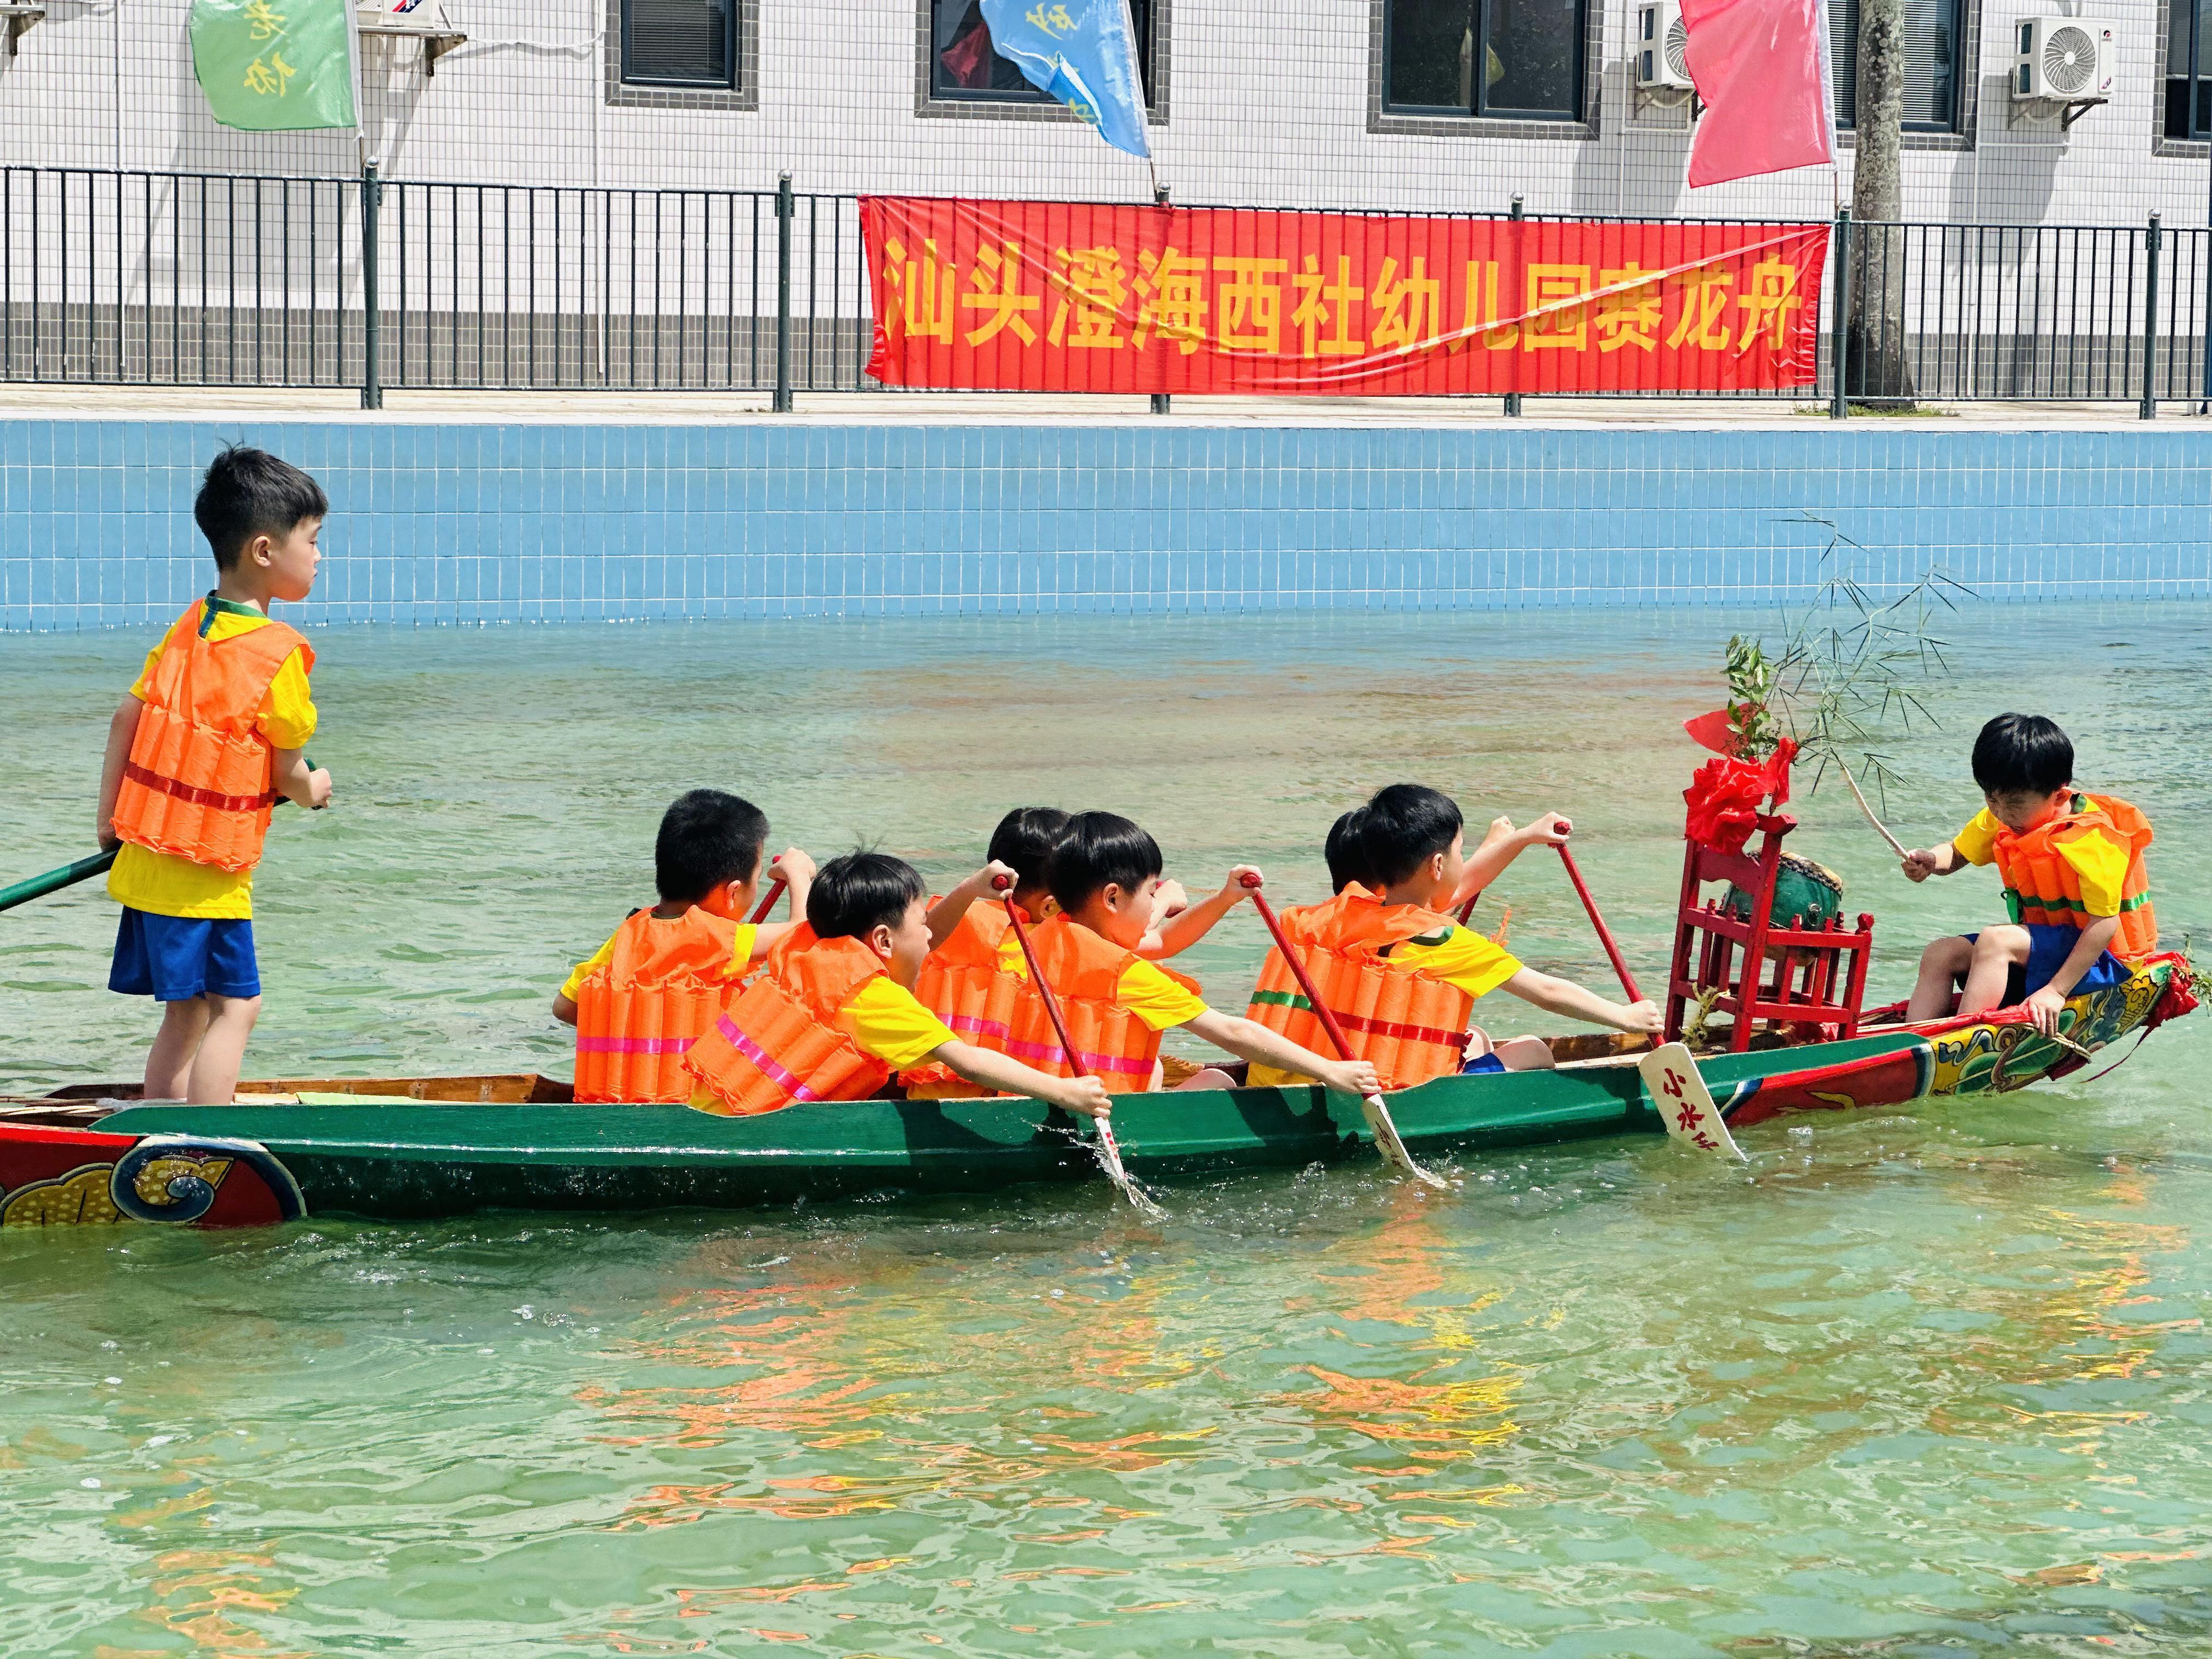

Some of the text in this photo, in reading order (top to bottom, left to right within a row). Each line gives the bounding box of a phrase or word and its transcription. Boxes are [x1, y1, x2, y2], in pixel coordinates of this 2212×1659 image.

[883, 236, 1802, 359] 汕头澄海西社幼儿园赛龙舟
